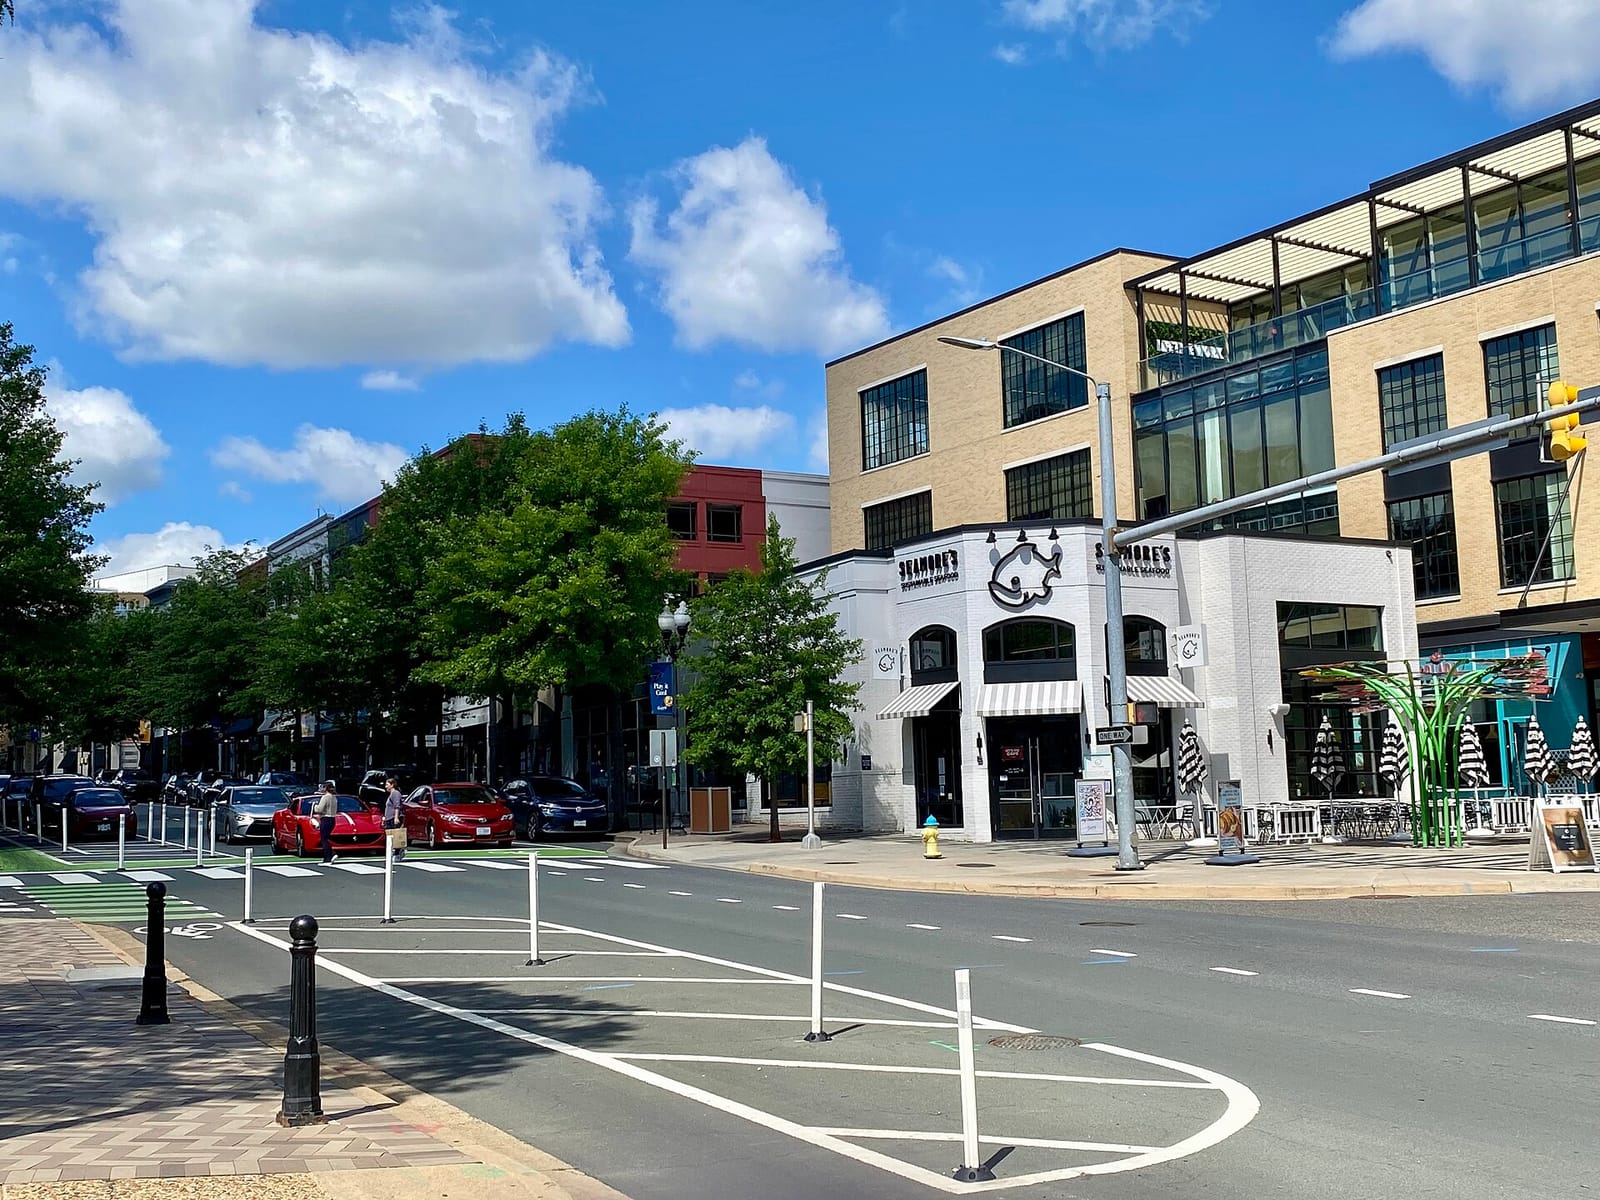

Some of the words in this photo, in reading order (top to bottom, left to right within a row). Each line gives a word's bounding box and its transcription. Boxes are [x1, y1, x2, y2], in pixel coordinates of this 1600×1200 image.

[1095, 542, 1170, 562] SMORE'S
[899, 549, 958, 577] SEAMORE'S
[934, 571, 959, 581] SEAFOOD
[1099, 732, 1112, 740] ONE
[1113, 731, 1125, 739] WAY
